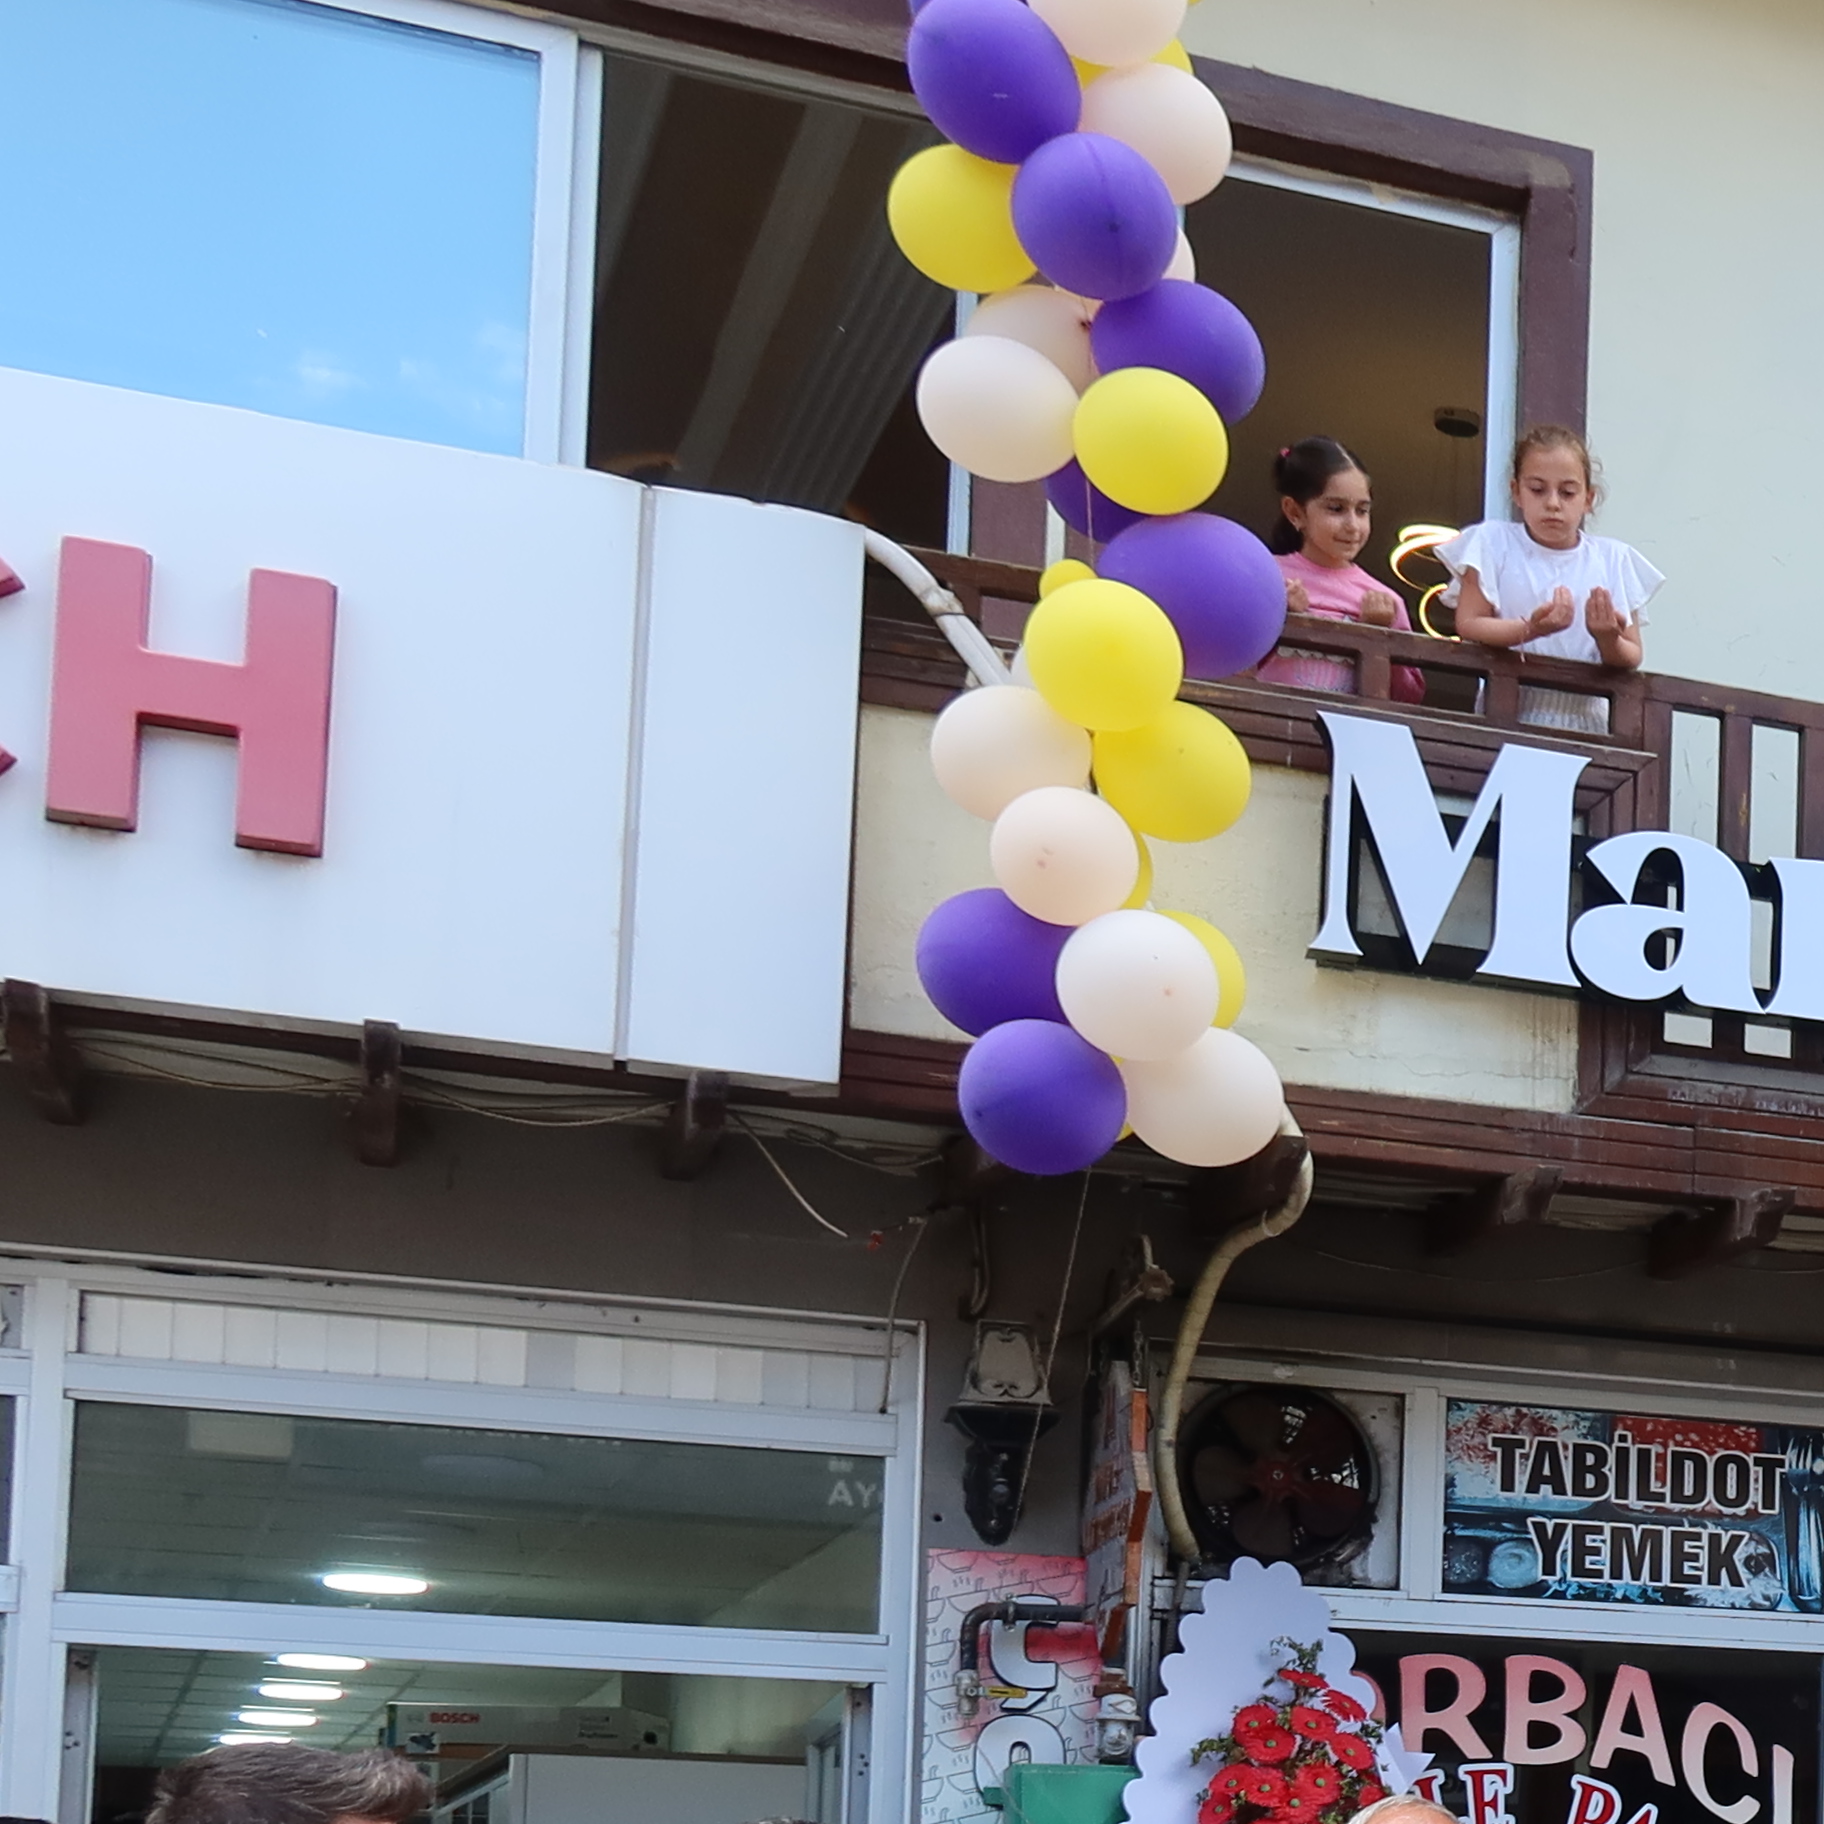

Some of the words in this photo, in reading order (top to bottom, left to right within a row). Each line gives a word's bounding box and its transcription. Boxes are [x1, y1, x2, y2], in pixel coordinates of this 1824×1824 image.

[0, 535, 338, 858] H
[1489, 1431, 1787, 1515] TABİLDOT
[1528, 1516, 1750, 1590] YEMEK
[429, 1712, 481, 1724] BOSCH
